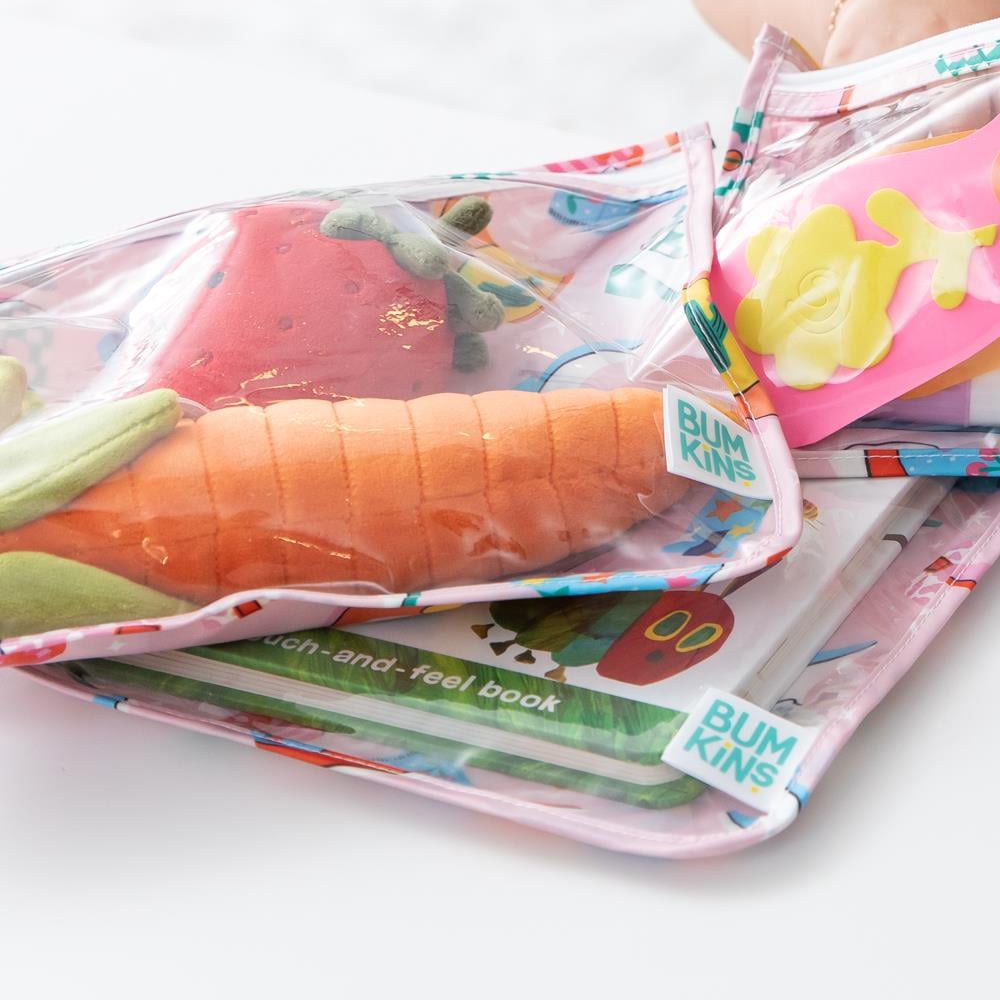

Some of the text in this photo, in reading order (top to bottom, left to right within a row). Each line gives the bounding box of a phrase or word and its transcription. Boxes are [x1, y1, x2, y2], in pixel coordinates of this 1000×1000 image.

[677, 399, 750, 462] BUM
[251, 630, 562, 713] uch-and-feel book
[701, 698, 798, 765] BUM
